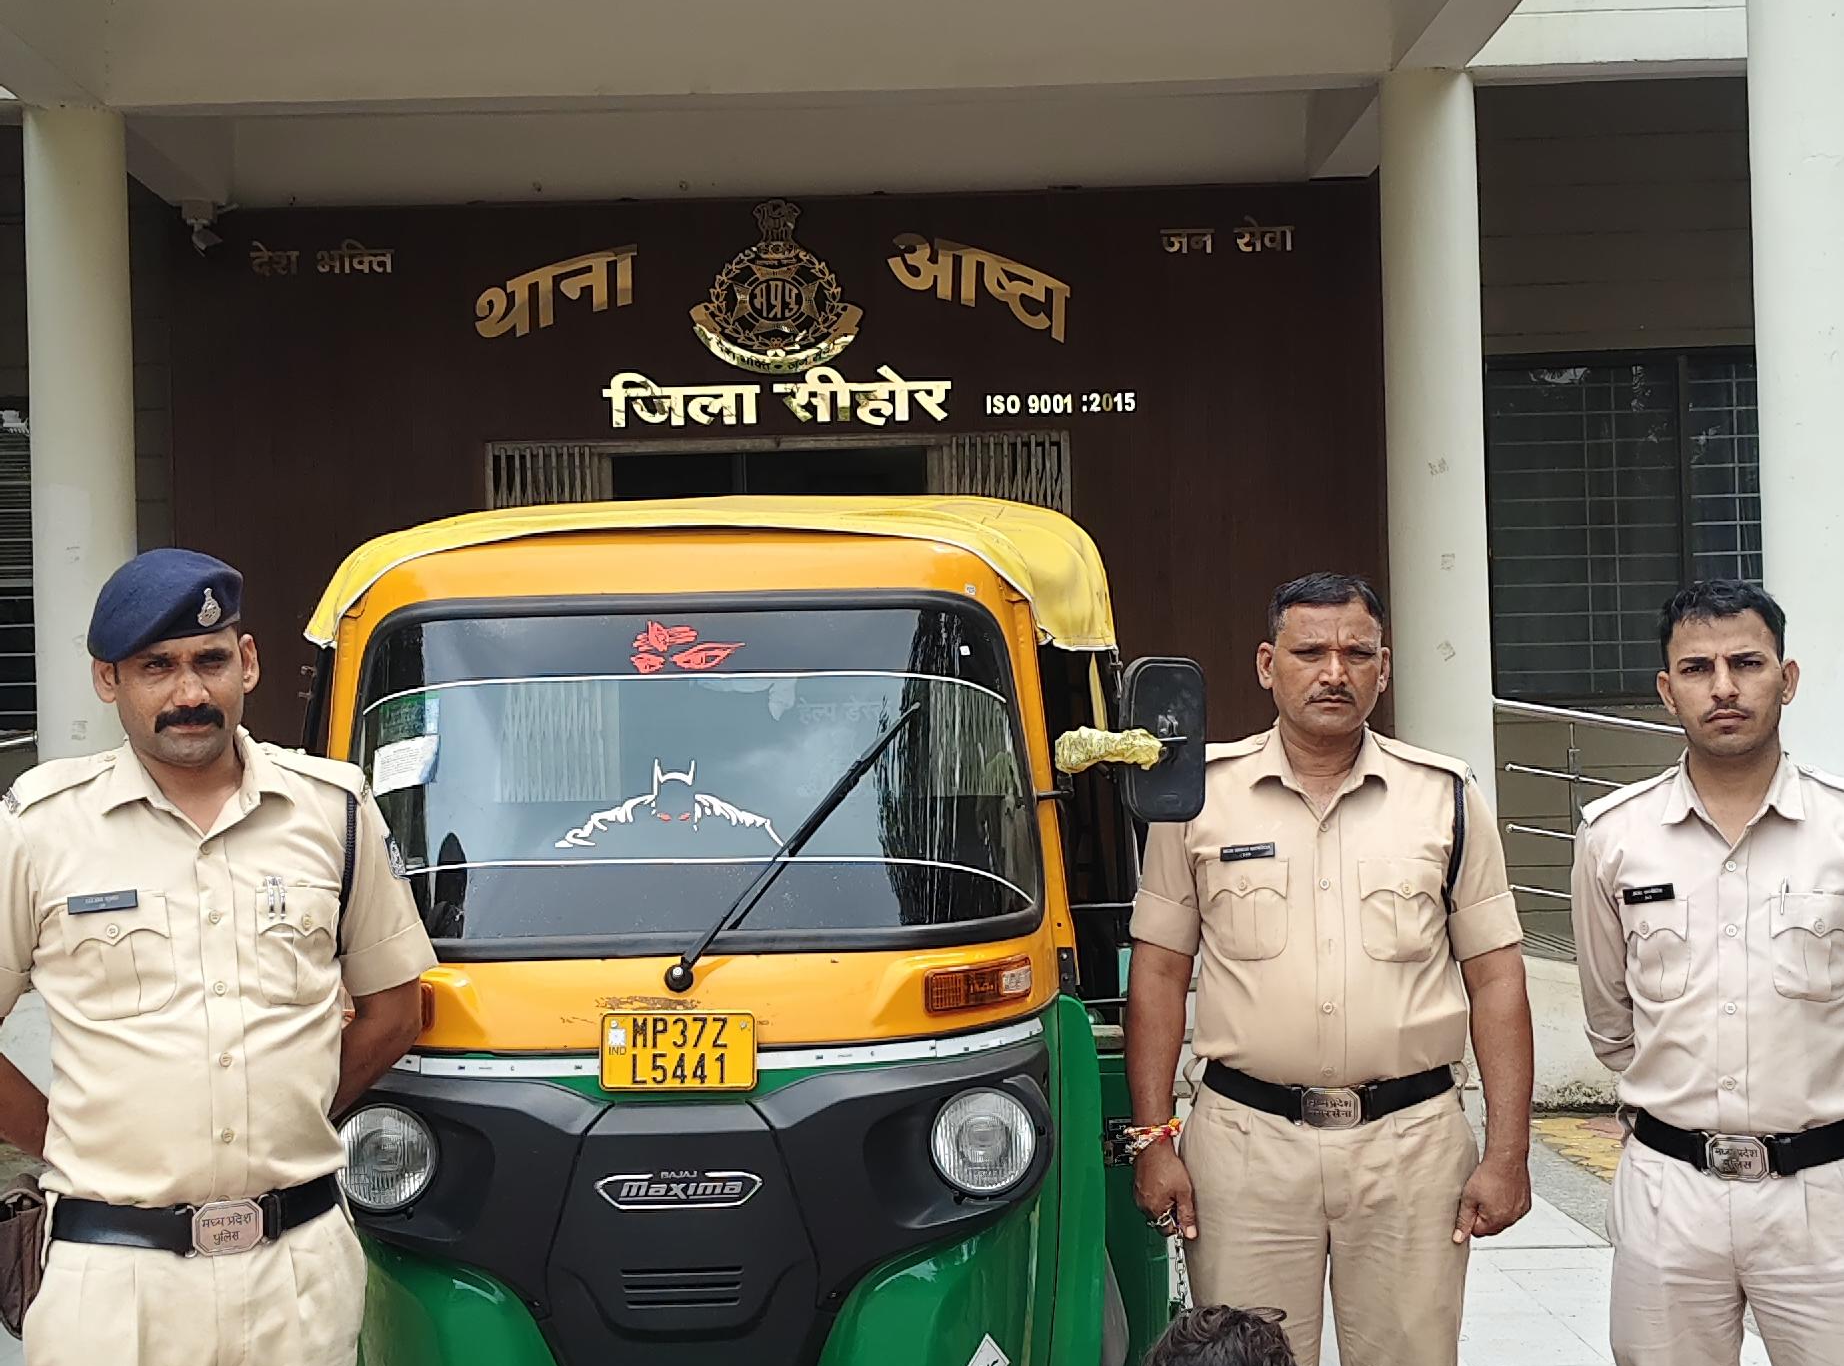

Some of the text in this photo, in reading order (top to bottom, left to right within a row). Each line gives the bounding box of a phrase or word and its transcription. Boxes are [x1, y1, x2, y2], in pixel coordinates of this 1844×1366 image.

[1160, 216, 1295, 254] जन सेवा
[250, 239, 394, 276] देश भक्ति
[475, 232, 1070, 343] थाना आष्टा
[602, 365, 952, 428] जिला सीहोर
[985, 394, 1020, 415] ISO
[1027, 393, 1073, 414] 9001
[632, 1017, 728, 1048] MP37Z
[609, 1046, 627, 1056] IND
[632, 1052, 726, 1084] L5441
[660, 1170, 698, 1179] BAJAJ
[227, 1212, 253, 1226] प्रदेश
[213, 1229, 240, 1245] पुलिस
